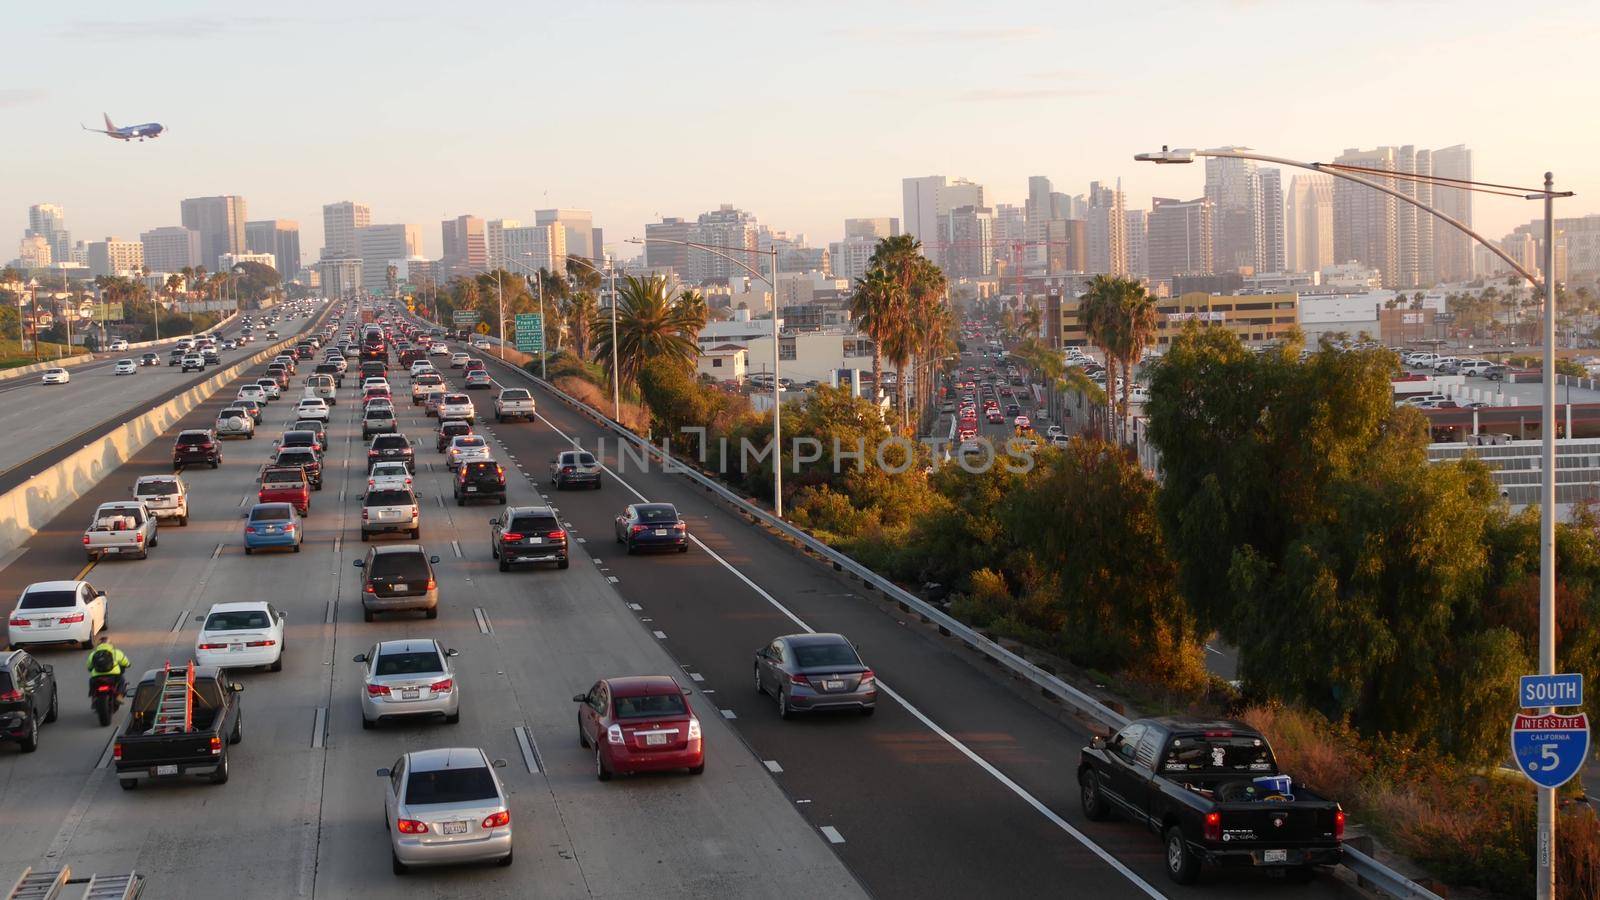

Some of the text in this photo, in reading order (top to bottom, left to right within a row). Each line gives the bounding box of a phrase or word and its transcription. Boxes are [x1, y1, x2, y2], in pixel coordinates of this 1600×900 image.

[1526, 682, 1576, 701] SOUTH
[1521, 718, 1579, 729] INTERSTATE
[1541, 743, 1560, 771] 5
